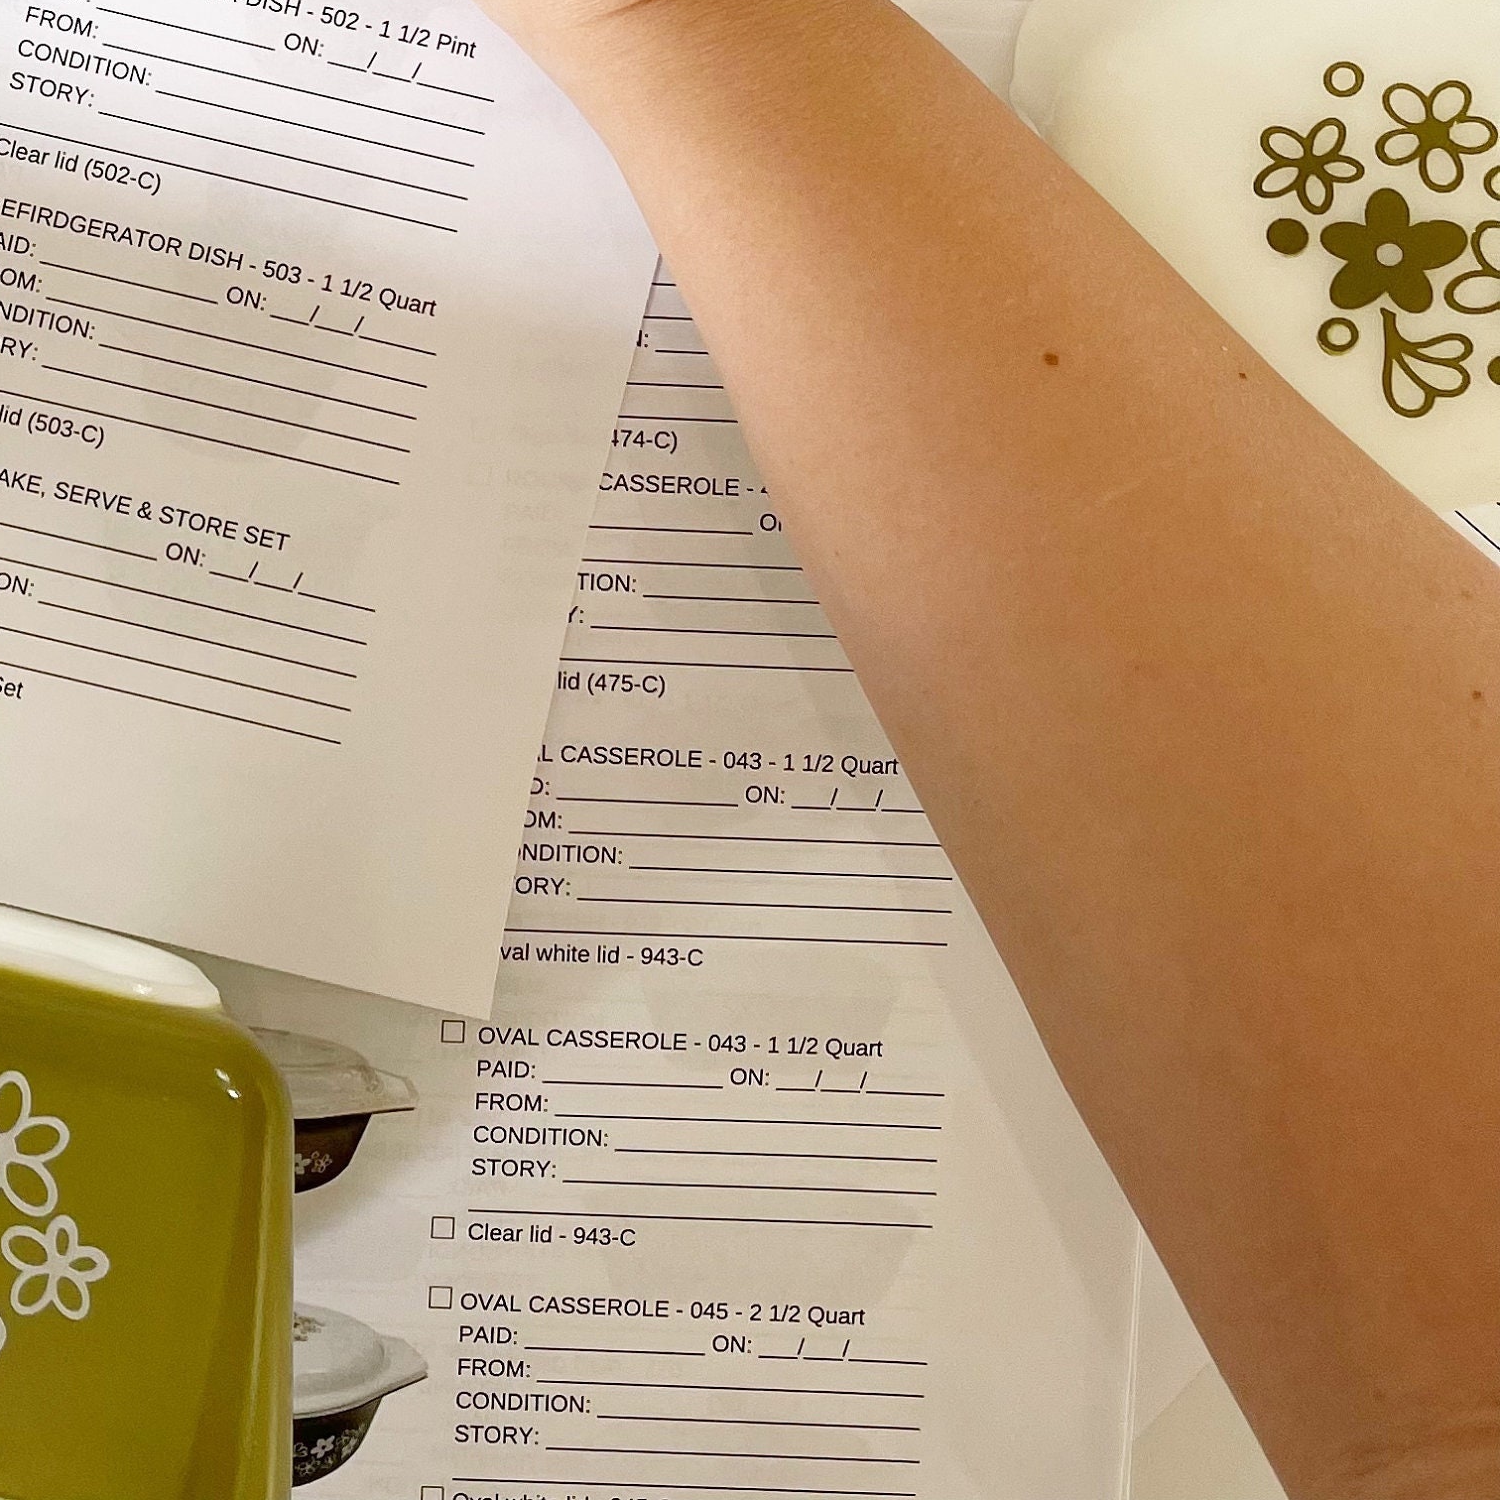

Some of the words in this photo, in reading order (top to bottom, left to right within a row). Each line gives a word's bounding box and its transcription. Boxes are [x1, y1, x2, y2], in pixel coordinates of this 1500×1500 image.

[25, 5, 99, 40] FROM:
[319, 5, 360, 31] 502
[378, 20, 391, 39] 1
[397, 24, 431, 48] 1/2
[435, 33, 477, 59] Pint
[283, 32, 325, 58] ON:
[17, 39, 152, 87] CONDITION:
[9, 71, 95, 108] STORY:
[53, 150, 80, 173] lid
[83, 157, 162, 197] (502-C)
[187, 241, 245, 272] DISH
[262, 259, 303, 285] 503
[320, 274, 333, 293] 1
[339, 278, 374, 302] 1/2
[378, 287, 438, 318] Quart
[226, 285, 267, 312] ON:
[27, 411, 105, 450] (503-C)
[53, 481, 133, 516] SERVE
[136, 500, 153, 521] &
[158, 505, 239, 541] STORE
[243, 525, 292, 551] SET
[165, 542, 207, 568] ON:
[557, 670, 581, 691] lid
[587, 672, 666, 699] (475-C)
[560, 744, 703, 769] CASSEROLE
[723, 750, 762, 771] 043
[782, 753, 796, 772] 1
[801, 753, 834, 773] 1/2
[840, 755, 900, 779] Quart
[745, 785, 786, 805] ON:
[535, 943, 591, 964] white
[596, 944, 620, 965] lid
[640, 946, 704, 967] 943-C
[478, 1026, 540, 1047] OVAL
[546, 1028, 688, 1051] CASSEROLE
[708, 1033, 747, 1053] 043
[767, 1035, 780, 1054] 1
[787, 1036, 819, 1056] 1/2
[825, 1037, 884, 1061] Quart
[476, 1059, 536, 1080] PAID:
[729, 1067, 770, 1087] ON:
[475, 1092, 549, 1113] FROM:
[473, 1125, 609, 1148] CONDITION:
[471, 1157, 557, 1179] STORY:
[467, 1222, 524, 1243] Clear
[529, 1224, 553, 1244] lid
[573, 1226, 636, 1247] 943-C
[460, 1292, 522, 1313] OVAL
[528, 1295, 670, 1318] CASSEROLE
[690, 1301, 729, 1321] 045
[749, 1303, 762, 1322] 2
[768, 1303, 801, 1324] 1/2
[807, 1305, 866, 1328] Quart
[458, 1324, 518, 1346] PAID:
[712, 1334, 752, 1354] ON:
[457, 1357, 531, 1379] FROM:
[455, 1390, 592, 1414] CONDITION:
[454, 1424, 540, 1446] STORY:
